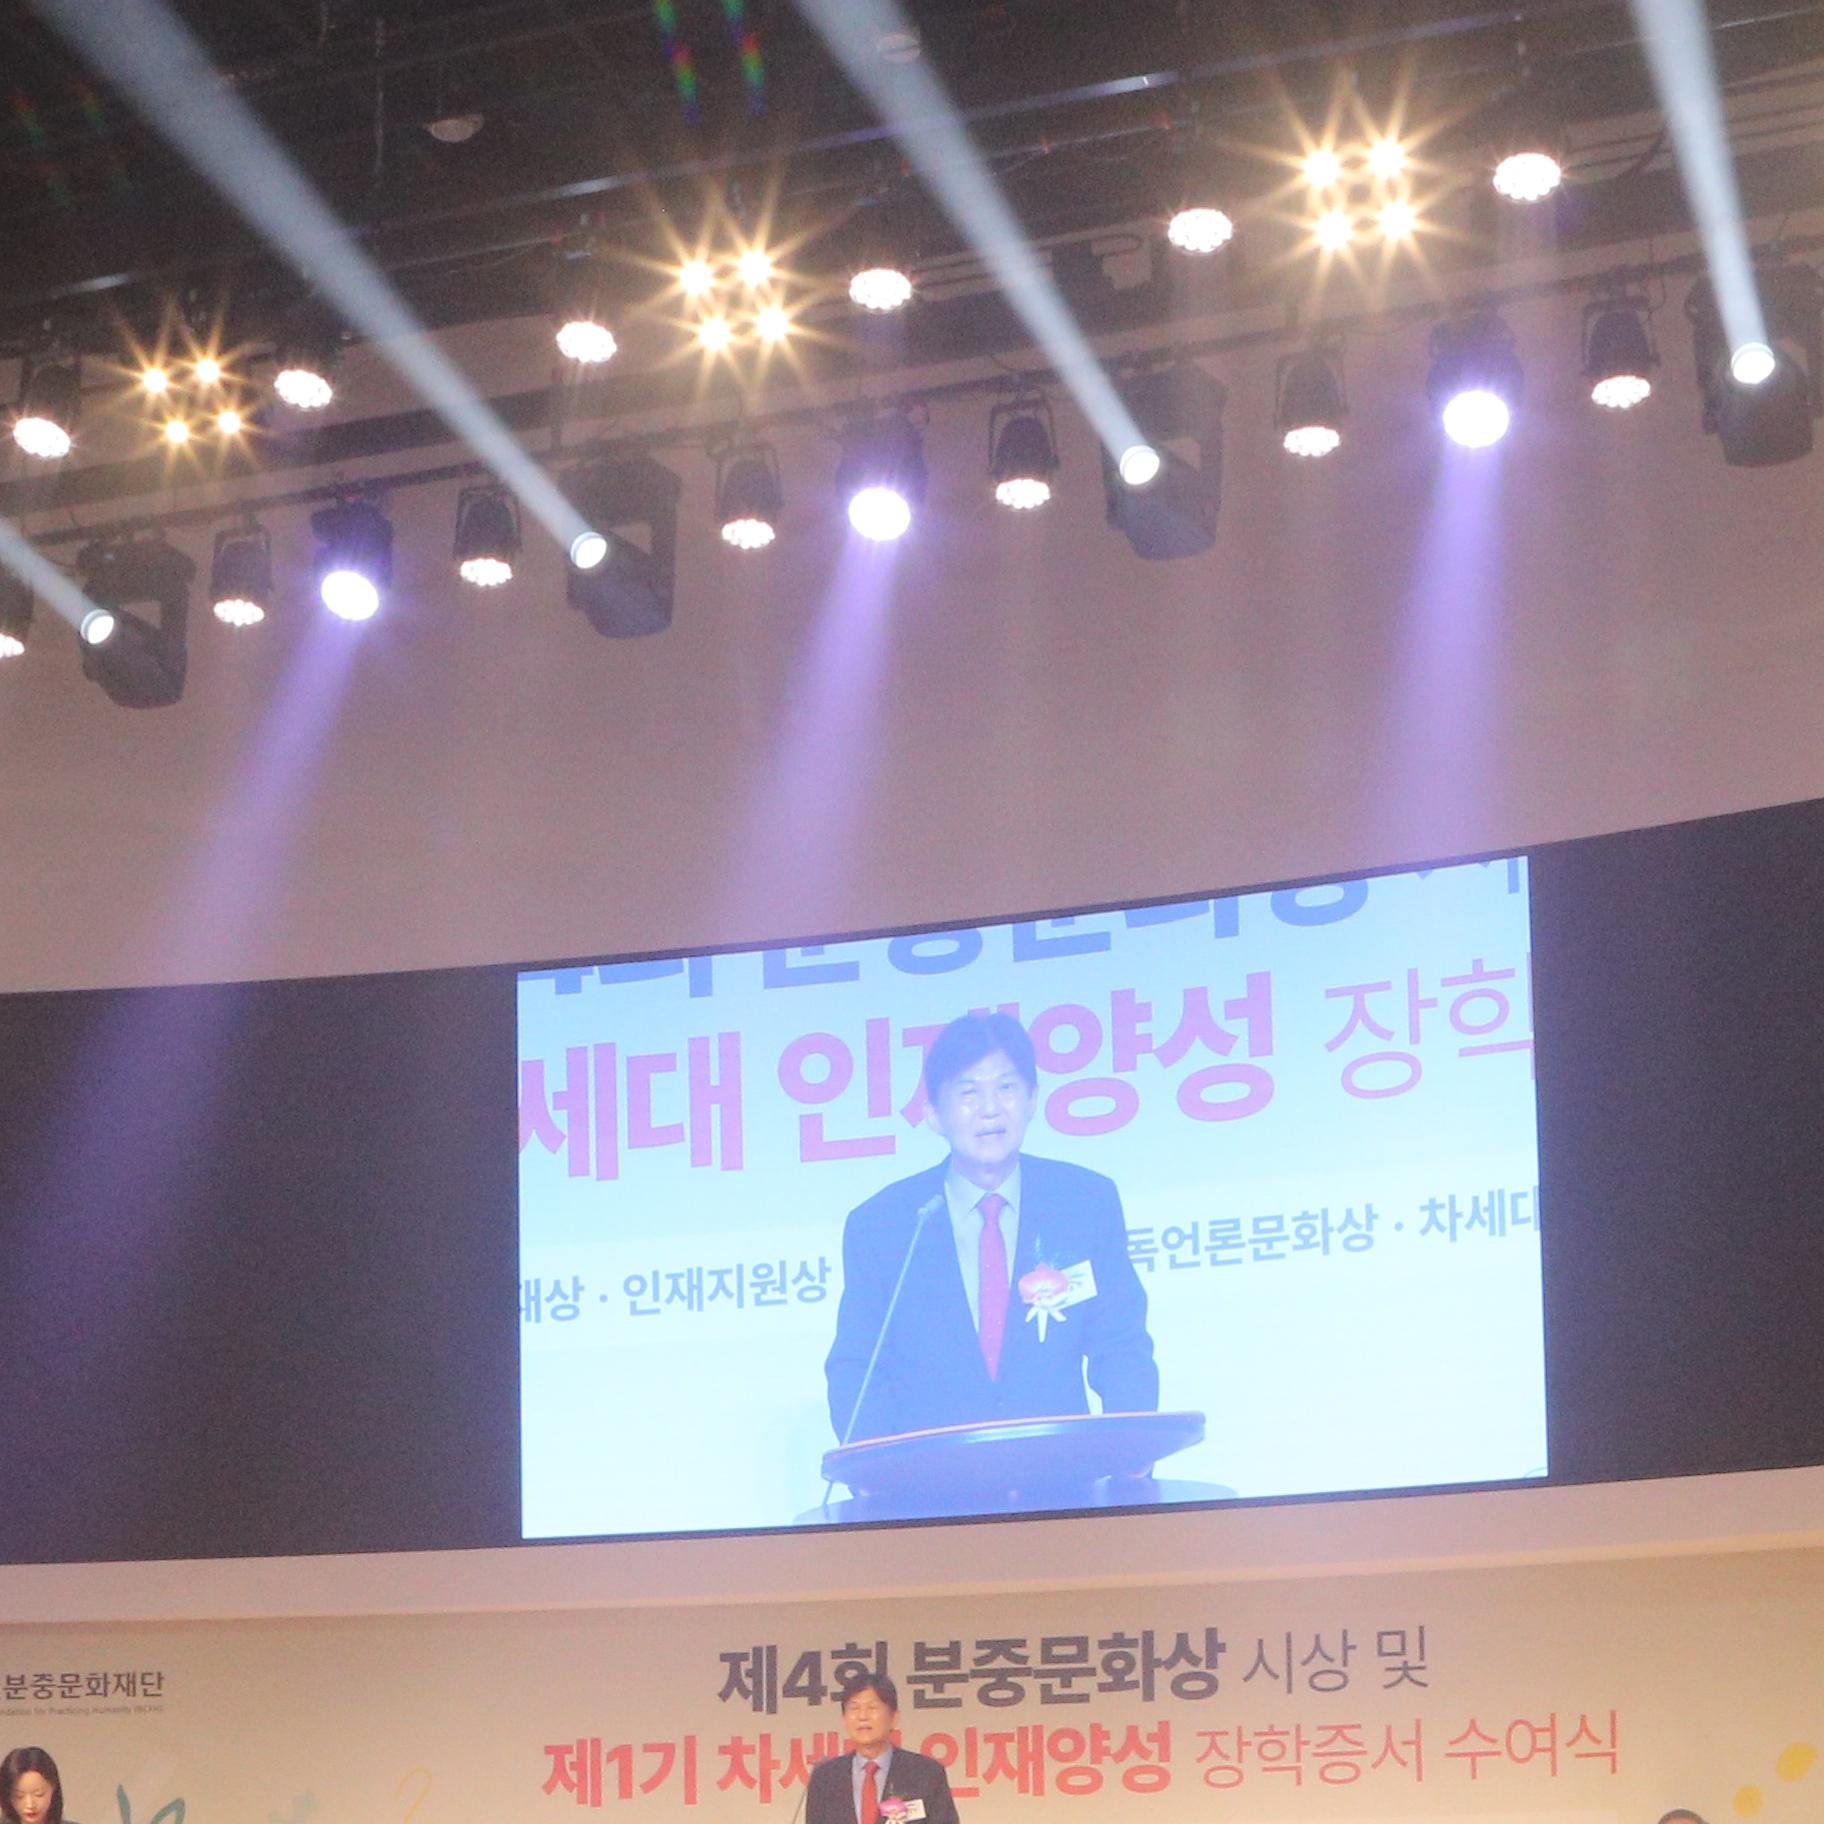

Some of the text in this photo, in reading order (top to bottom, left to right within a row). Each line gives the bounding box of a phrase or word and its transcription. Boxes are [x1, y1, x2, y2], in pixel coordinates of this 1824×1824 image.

[622, 1256, 832, 1316] 인재지원상
[907, 1628, 1226, 1709] 분중문화상
[1242, 1628, 1357, 1694] 시상
[1376, 1625, 1429, 1690] 및
[542, 1734, 697, 1808] 제1기
[919, 1720, 1172, 1800] 인재양성
[1195, 1718, 1424, 1790] 장학증서
[1444, 1709, 1619, 1780] 수여식
